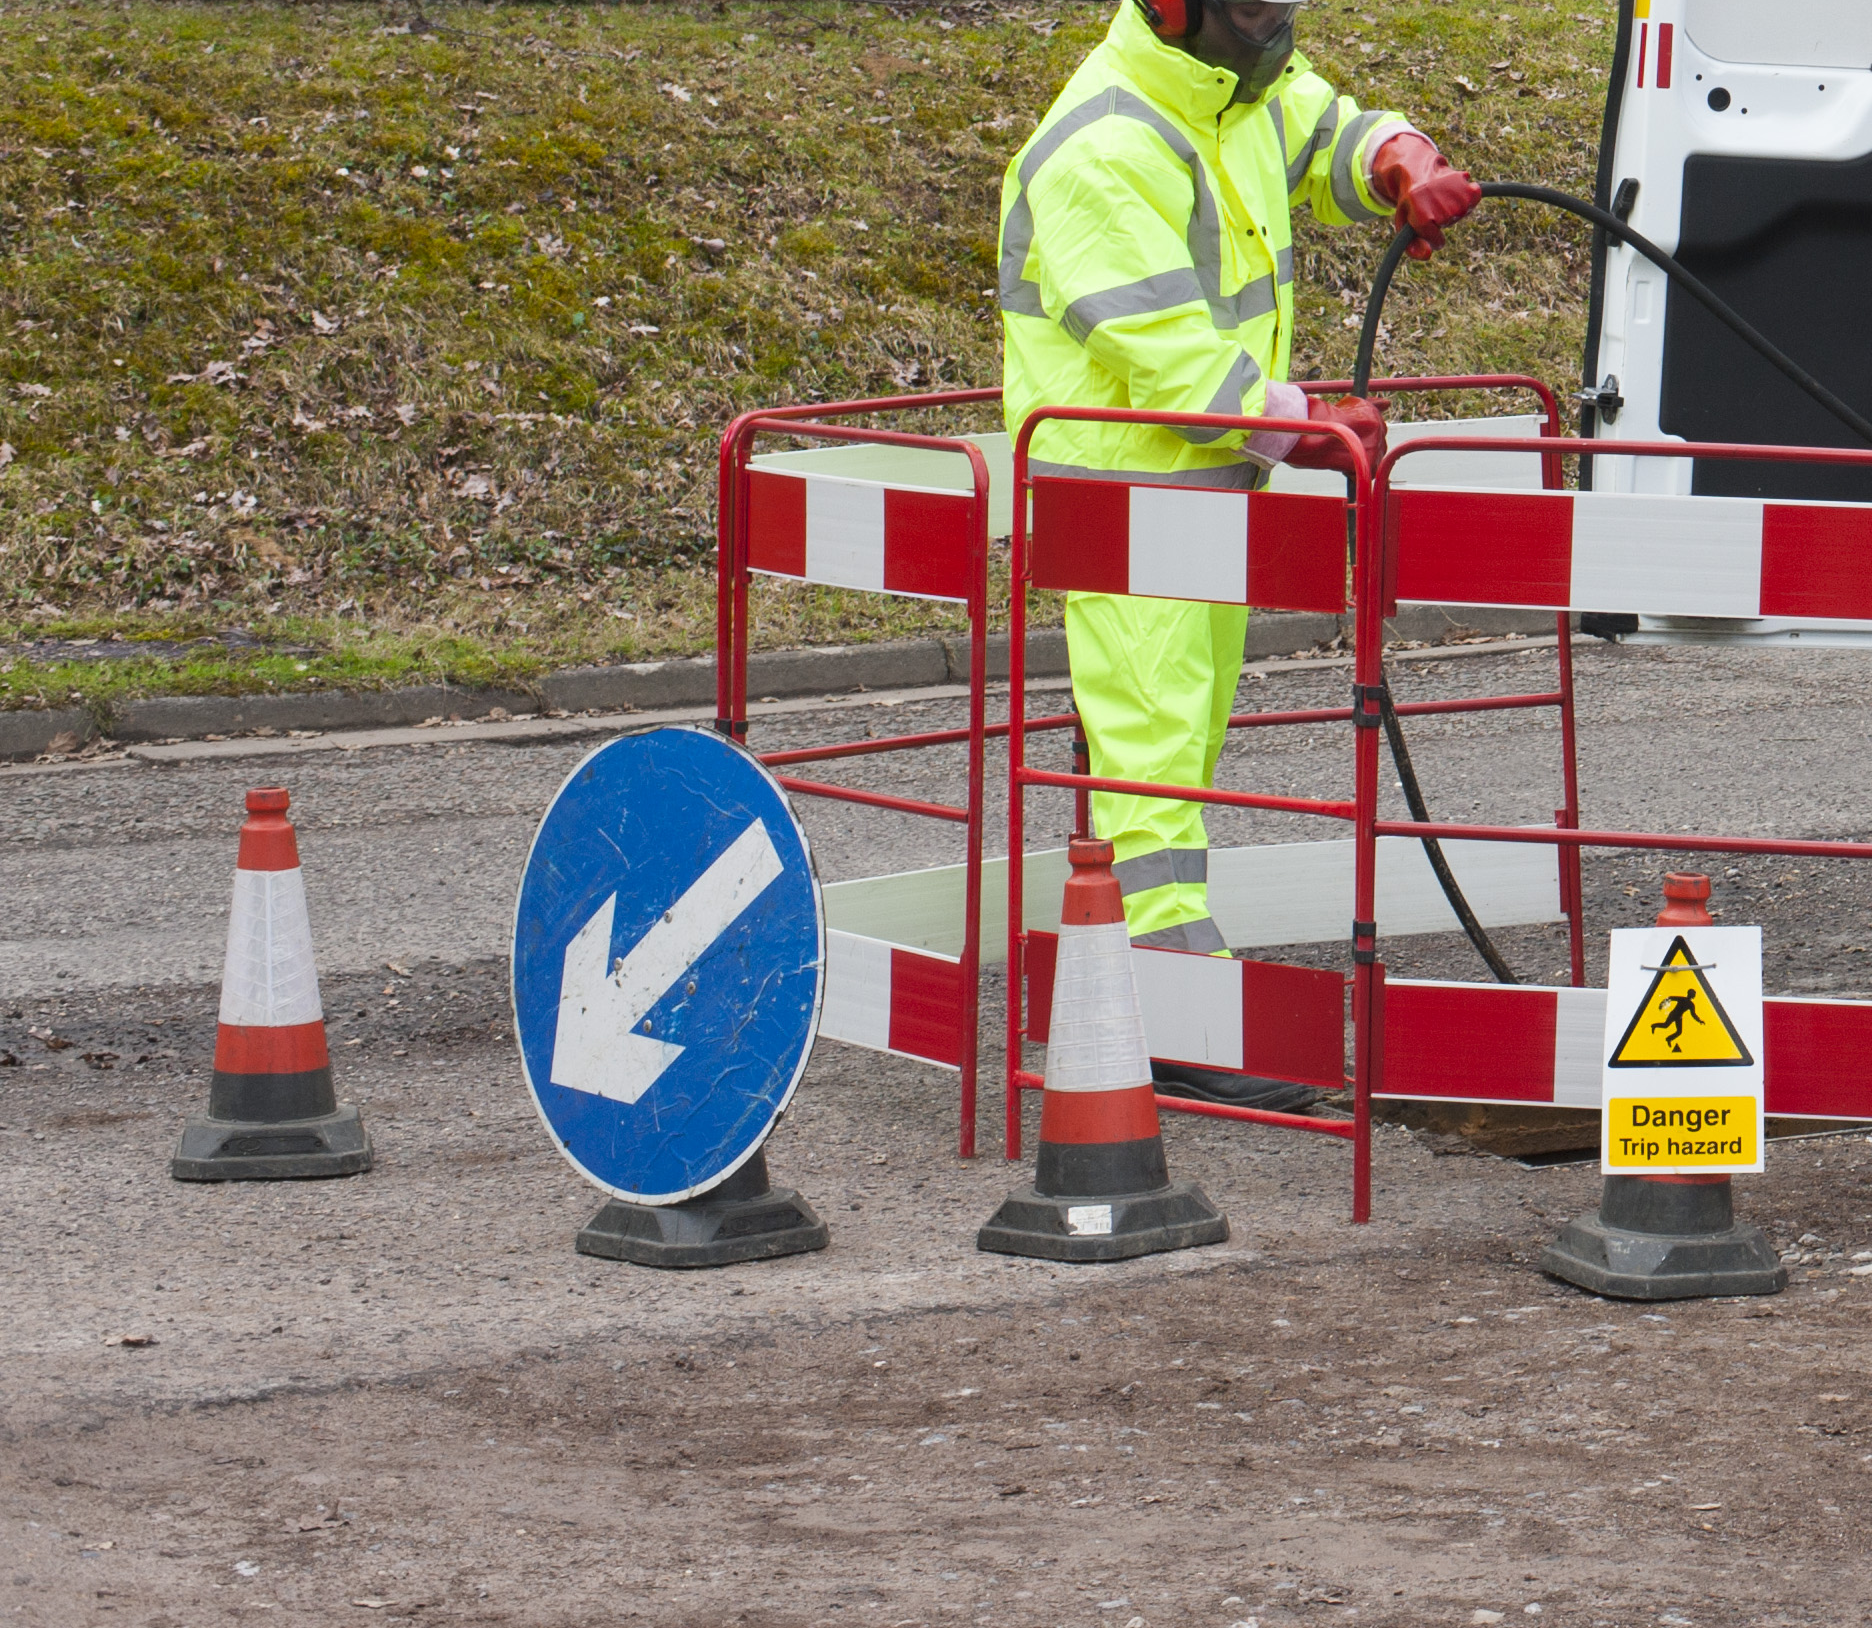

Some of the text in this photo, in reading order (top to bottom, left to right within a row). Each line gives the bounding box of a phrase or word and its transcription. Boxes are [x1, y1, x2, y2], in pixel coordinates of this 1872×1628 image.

[1632, 1105, 1731, 1132] Danger
[1619, 1136, 1742, 1160] Trip hazard
